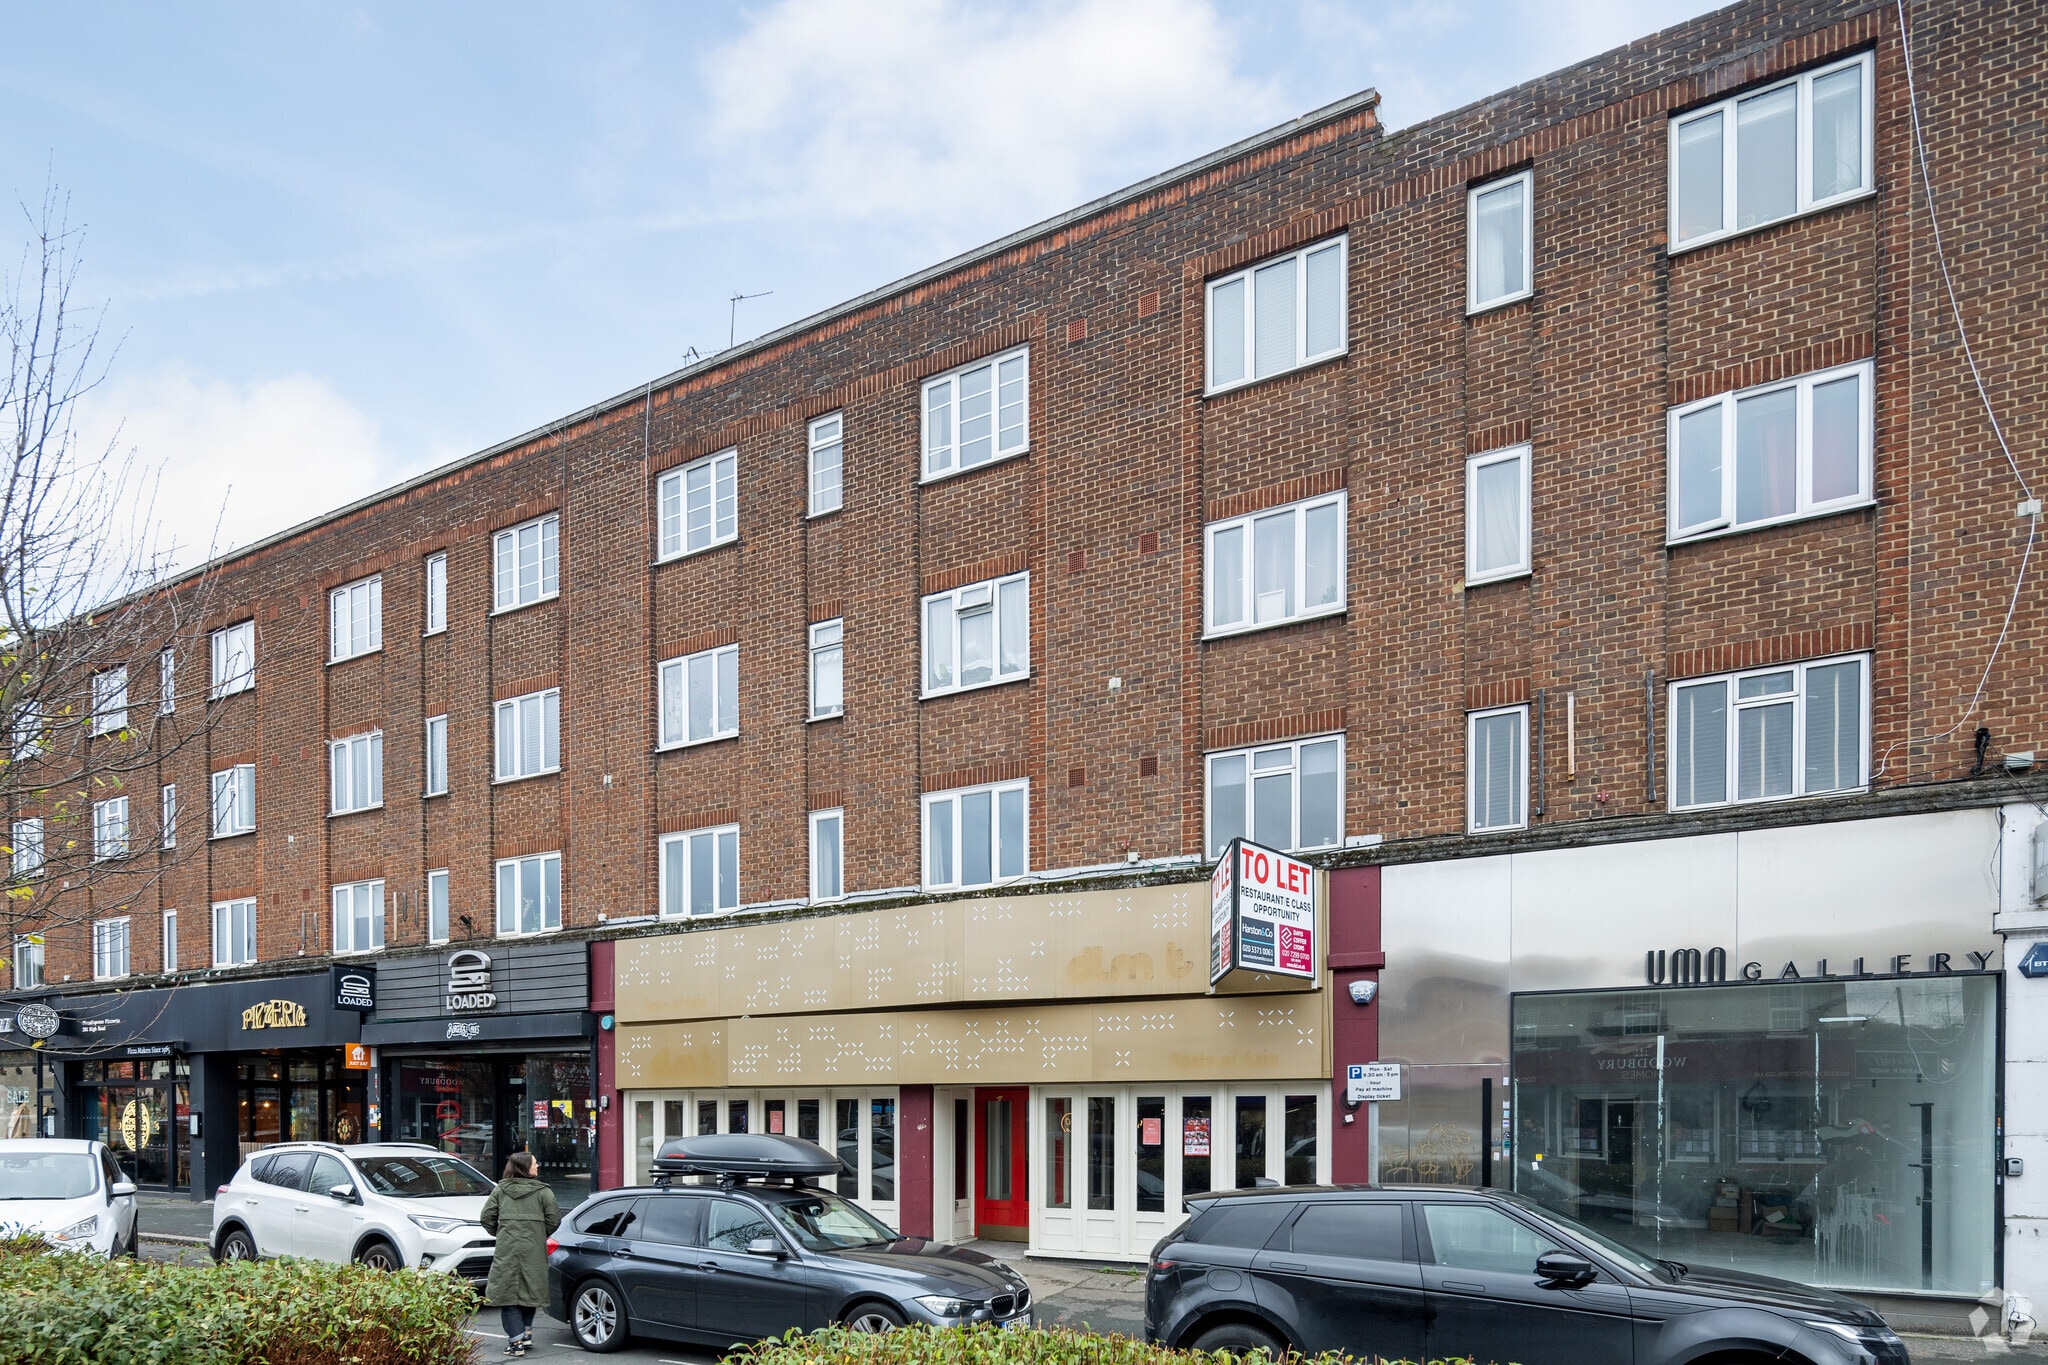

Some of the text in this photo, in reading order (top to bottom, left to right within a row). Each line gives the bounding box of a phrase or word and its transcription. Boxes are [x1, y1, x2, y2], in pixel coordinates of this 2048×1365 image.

[1242, 847, 1310, 895] TO LET
[1213, 871, 1220, 899] TO
[1253, 903, 1300, 921] OPPORTUNITY
[1292, 899, 1312, 913] CLASS
[1242, 923, 1273, 938] Harston&Co
[1242, 944, 1251, 952] 020
[1742, 950, 1994, 981] GALLERY
[338, 996, 373, 1007] LOADED
[447, 993, 495, 1010] LOADED
[242, 1000, 307, 1030] PIZZERIA
[1352, 1068, 1360, 1078] P
[7, 1090, 29, 1104] SALE
